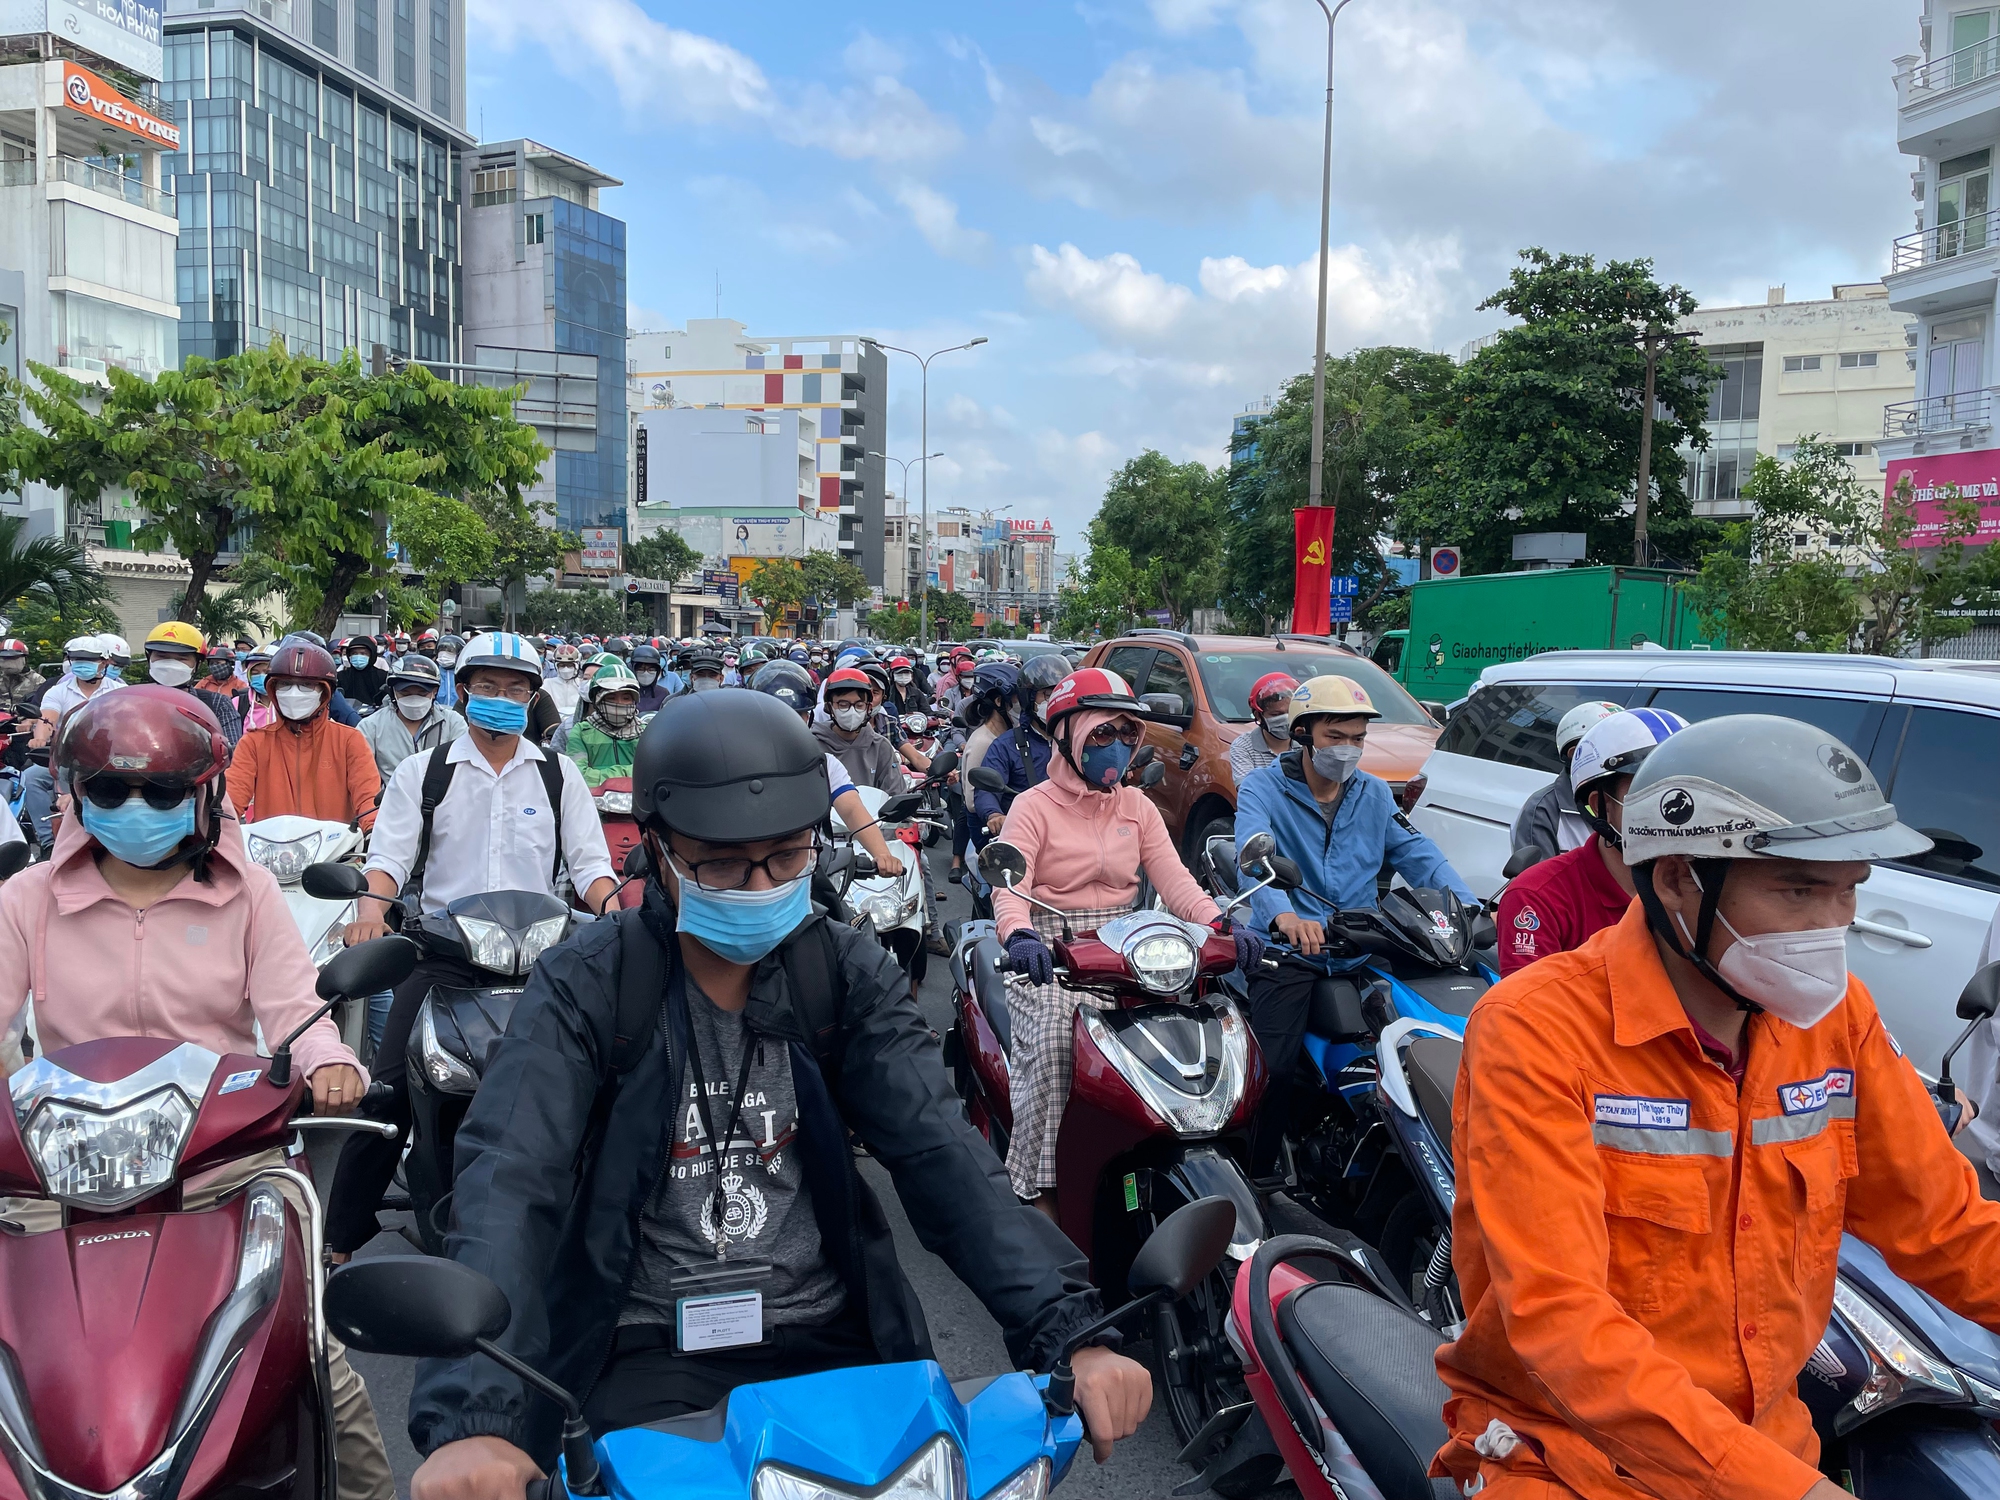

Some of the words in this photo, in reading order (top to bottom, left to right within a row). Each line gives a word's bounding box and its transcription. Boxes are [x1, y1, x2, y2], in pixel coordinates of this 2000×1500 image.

[135, 114, 180, 145] VINH
[1982, 477, 1999, 497] VÀ
[1041, 516, 1052, 531] Á
[102, 561, 189, 574] SHOWROOM
[1515, 932, 1536, 946] SPA
[692, 1159, 714, 1178] RUE
[78, 1230, 152, 1247] HONDA
[1805, 1364, 1841, 1393] NDA
